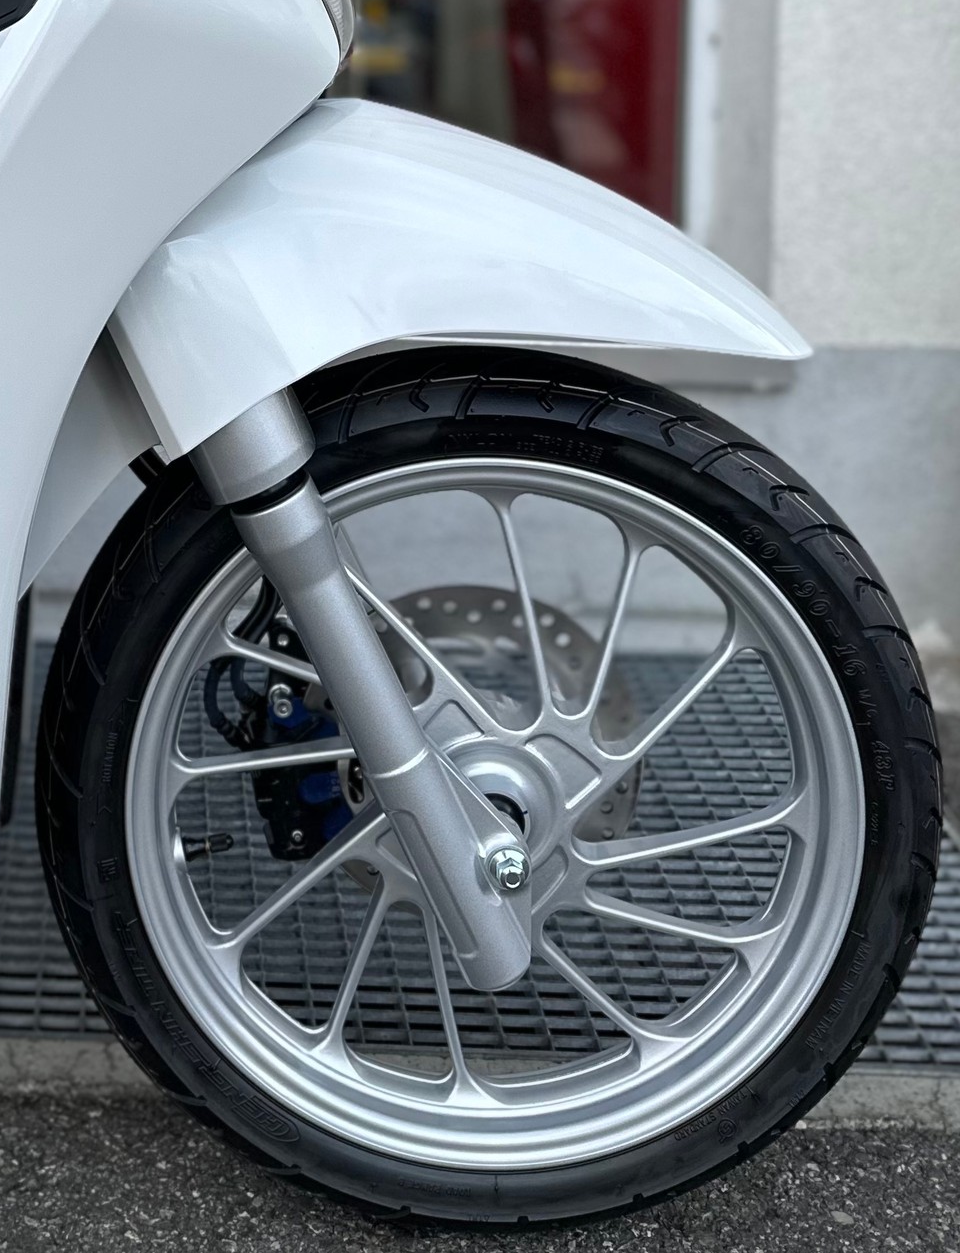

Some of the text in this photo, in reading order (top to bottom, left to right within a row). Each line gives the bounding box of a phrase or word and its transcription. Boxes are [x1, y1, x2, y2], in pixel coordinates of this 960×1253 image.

[740, 524, 868, 678] 80/90-16
[100, 731, 119, 782] ROTATION
[805, 942, 872, 1049] MADE IN VIETNAM
[152, 1002, 211, 1071] SHIN
[673, 1111, 717, 1142] STANDARD
